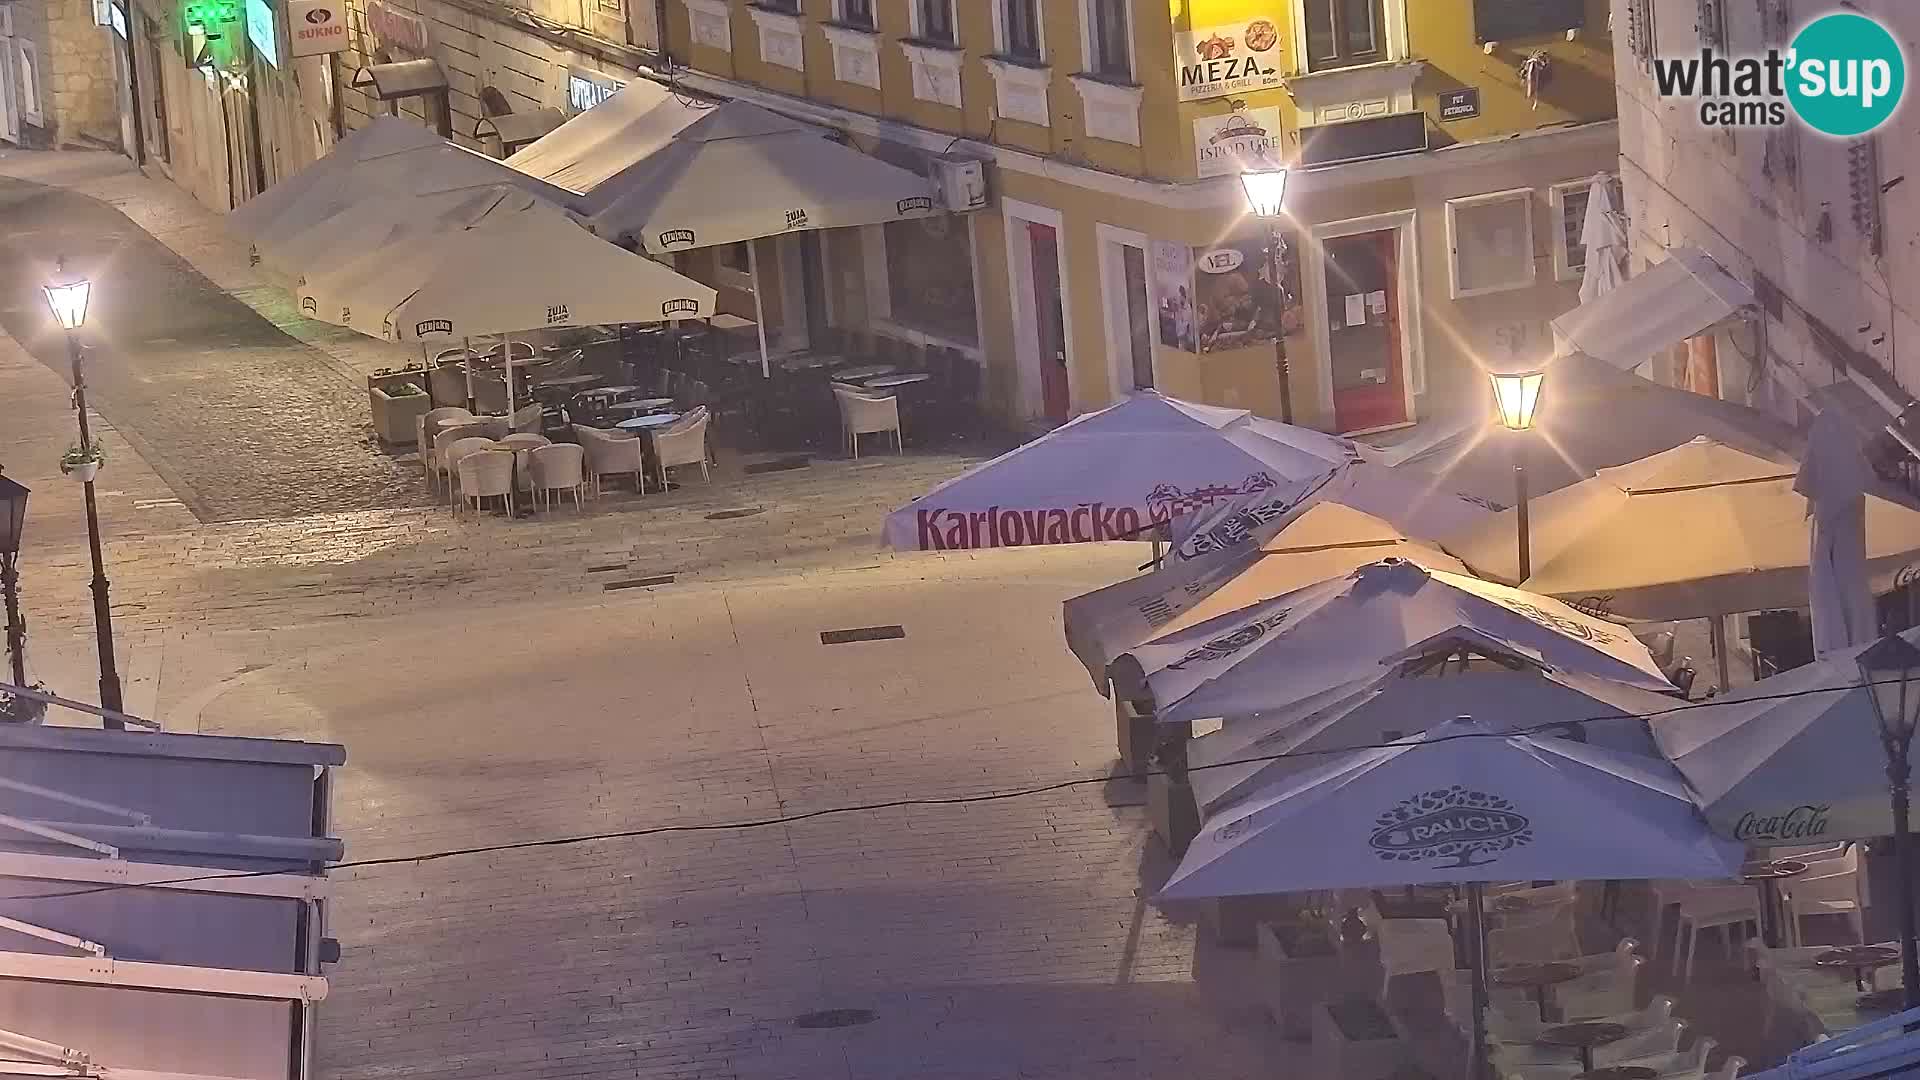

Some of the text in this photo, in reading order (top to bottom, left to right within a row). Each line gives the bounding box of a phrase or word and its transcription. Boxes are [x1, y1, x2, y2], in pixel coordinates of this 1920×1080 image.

[298, 25, 342, 39] SUKNO
[1181, 56, 1260, 87] MEZA
[1191, 82, 1223, 94] PIZZERIA
[1231, 79, 1252, 88] GRILL
[1200, 142, 1245, 160] ISPOD
[918, 503, 1139, 550] Karlovačko
[1412, 816, 1510, 841] RAUCH
